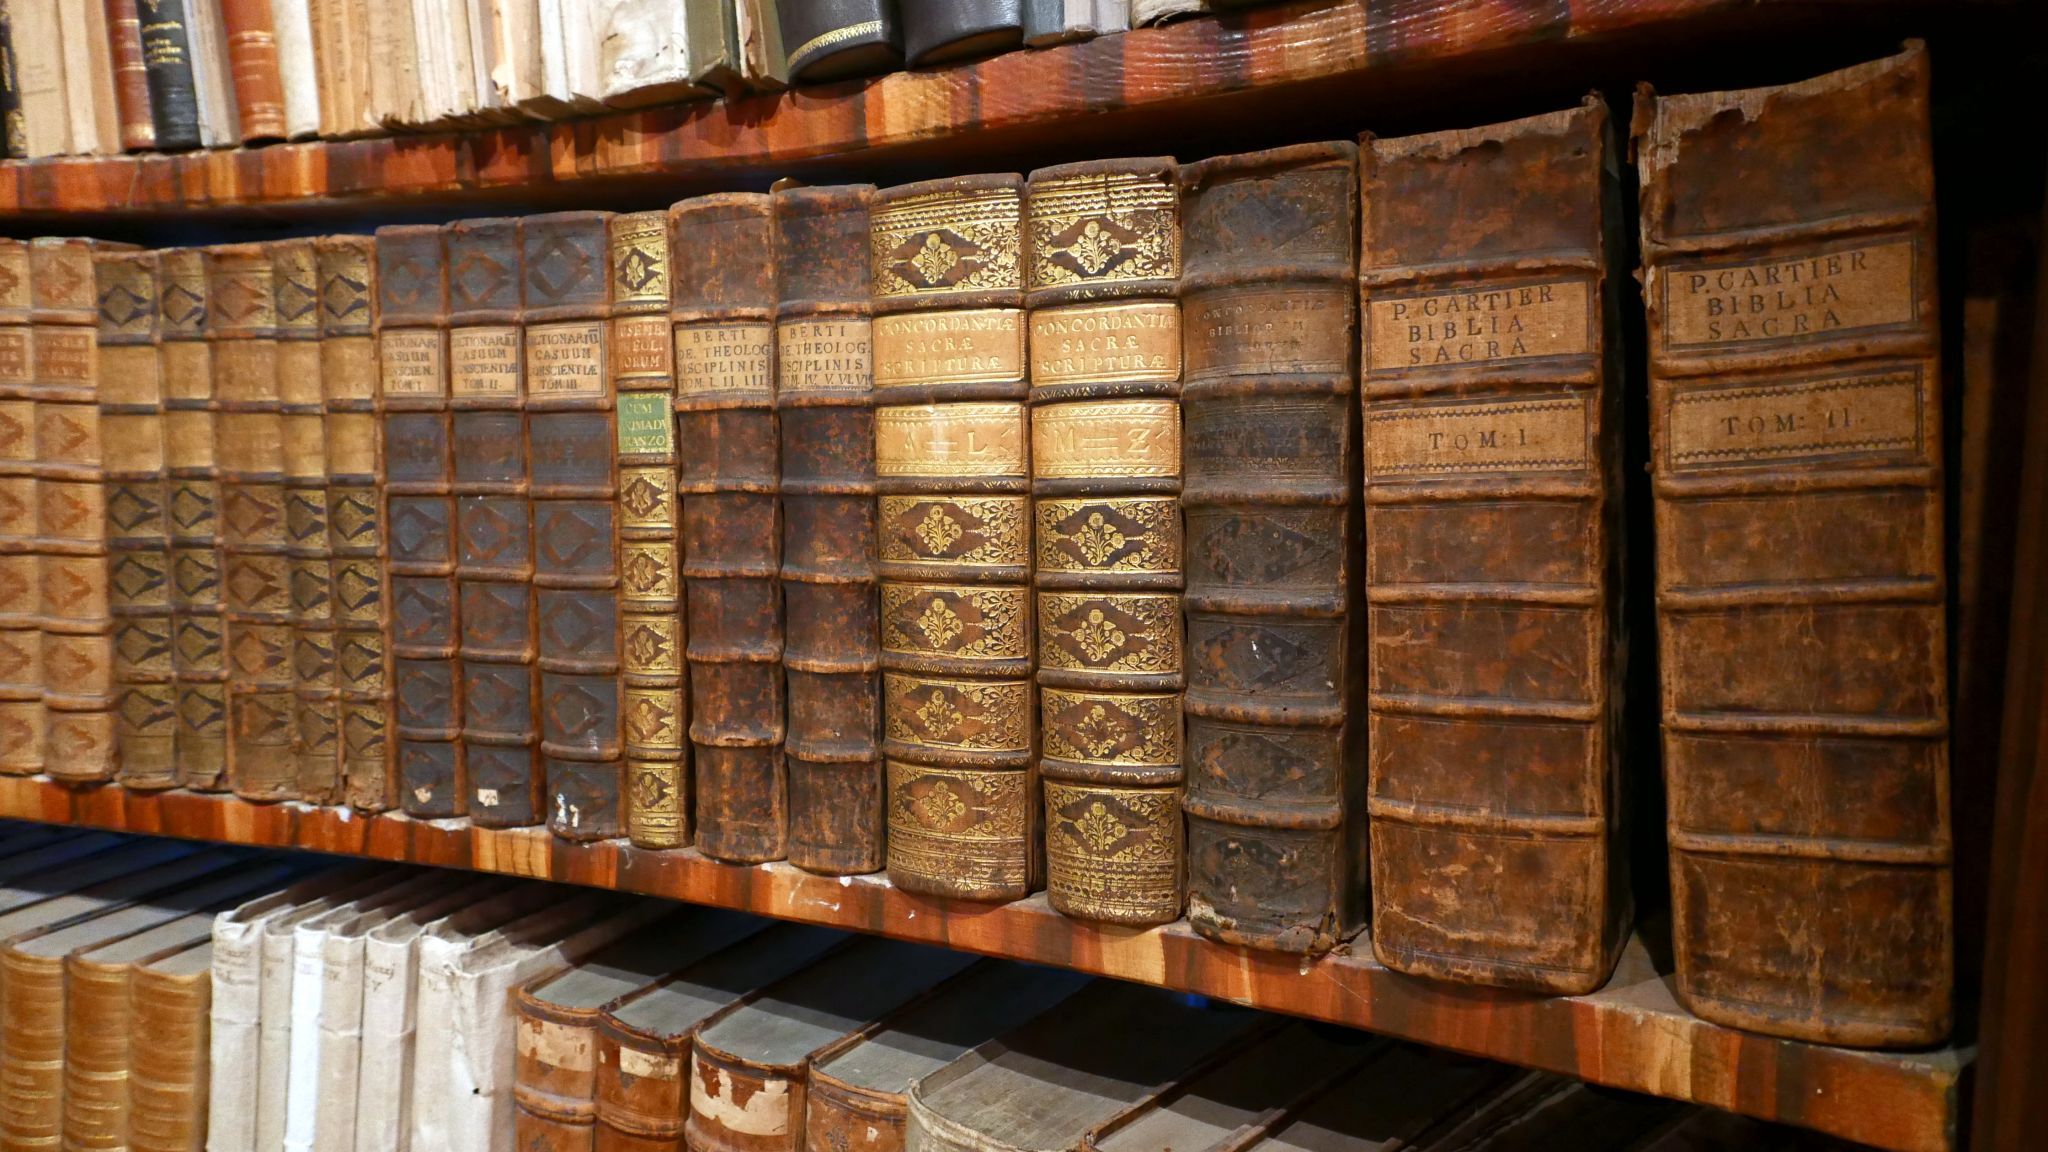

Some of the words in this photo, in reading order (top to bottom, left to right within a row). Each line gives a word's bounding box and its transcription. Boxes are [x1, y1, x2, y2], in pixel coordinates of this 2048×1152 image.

[1423, 285, 1554, 317] CARTIER
[1708, 283, 1840, 317] BIBLIA
[790, 325, 846, 339] BERTI
[1408, 314, 1524, 343] BIBLIA
[1709, 309, 1842, 340] SACRA
[693, 329, 747, 344] BERTI
[384, 351, 430, 362] ASUUM
[535, 347, 592, 360] CASUUM
[1410, 337, 1527, 364] SACRA
[453, 362, 518, 374] NSCIENTIÆ
[1041, 354, 1168, 374] SCRIPTURÆ
[967, 431, 989, 454] L
[1054, 428, 1076, 453] M
[1127, 428, 1152, 453] Z
